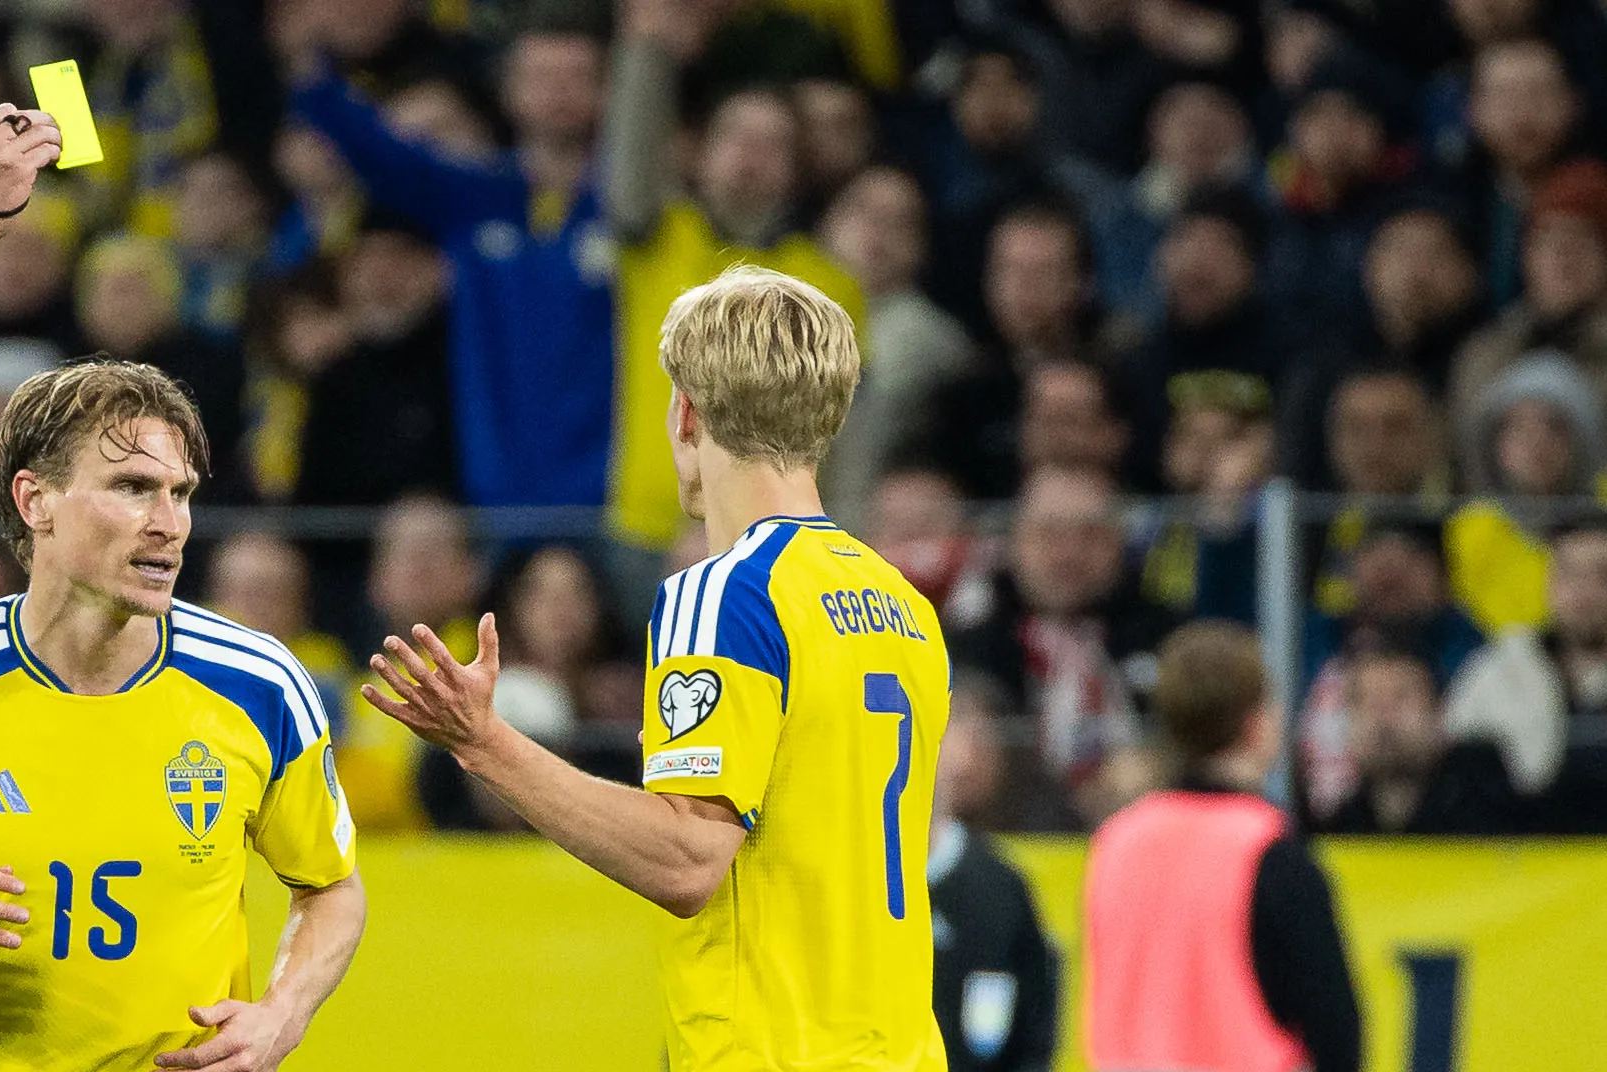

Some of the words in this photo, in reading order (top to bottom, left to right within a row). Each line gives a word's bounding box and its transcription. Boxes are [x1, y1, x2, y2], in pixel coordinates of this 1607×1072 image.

[821, 588, 927, 641] BERGVALL
[174, 768, 218, 779] SVERIGE
[864, 673, 912, 920] 7
[49, 860, 142, 960] 15
